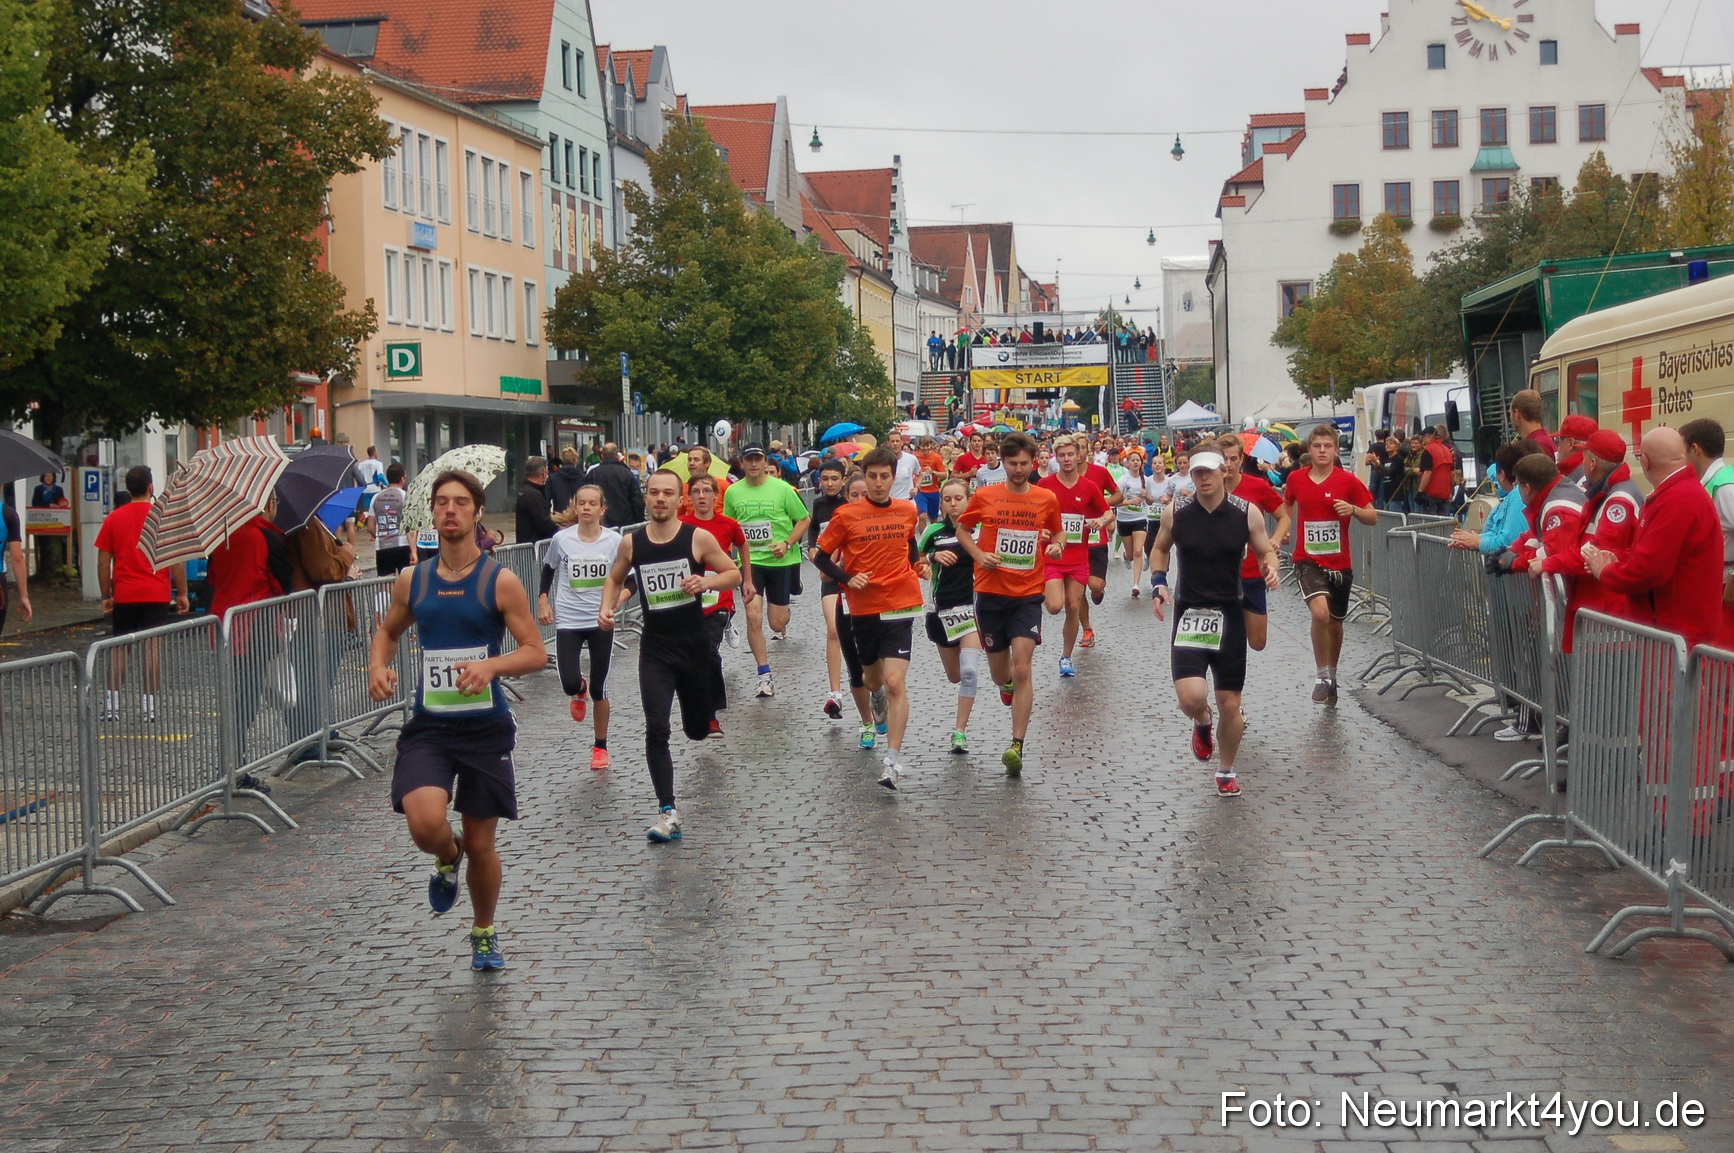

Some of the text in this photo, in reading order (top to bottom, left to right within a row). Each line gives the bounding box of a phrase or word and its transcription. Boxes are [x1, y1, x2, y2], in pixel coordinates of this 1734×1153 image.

[392, 348, 415, 372] D
[1659, 340, 1734, 383] Bayerisches
[1015, 371, 1062, 384] START
[1659, 386, 1693, 415] Rotes
[88, 475, 97, 489] P
[1012, 511, 1037, 519] LAUFEN
[866, 523, 905, 533] WIR LAUFEN
[990, 518, 1010, 526] NICHT
[419, 533, 436, 541] 2301
[745, 528, 769, 540] 5026
[860, 534, 881, 542] NICHT
[1308, 529, 1337, 542] 5153
[1000, 538, 1034, 554] 5086
[999, 556, 1031, 564] Christopher
[572, 564, 607, 578] 5190
[647, 571, 685, 592] 5071
[655, 592, 684, 603] Benedikt
[1182, 617, 1219, 634] 5186
[424, 654, 477, 663] PARTL Neumarkt
